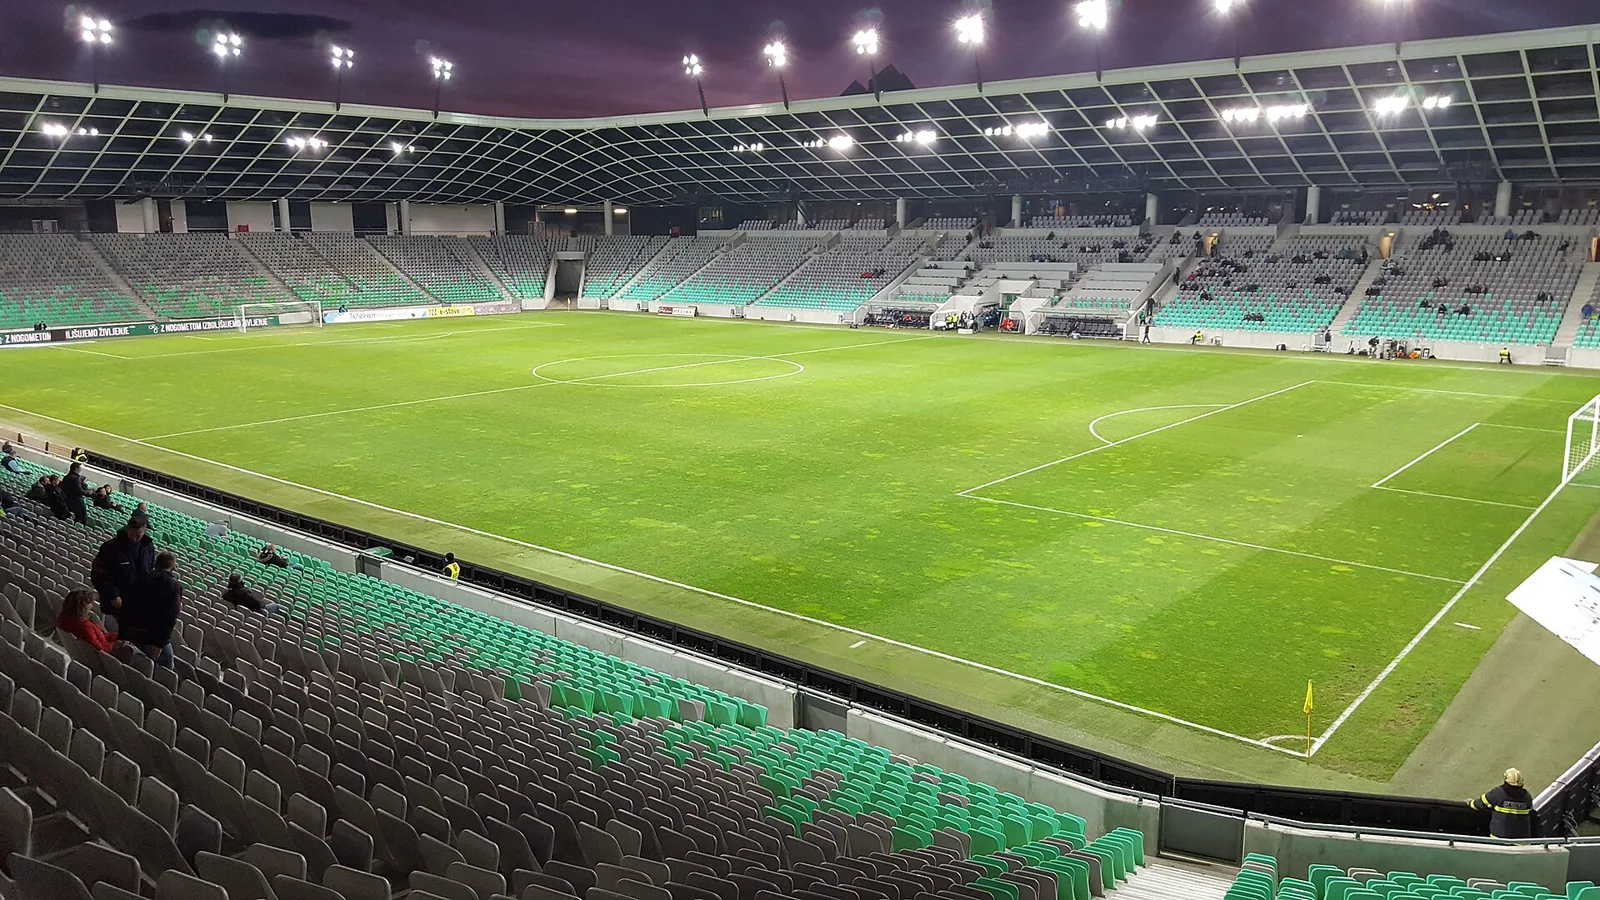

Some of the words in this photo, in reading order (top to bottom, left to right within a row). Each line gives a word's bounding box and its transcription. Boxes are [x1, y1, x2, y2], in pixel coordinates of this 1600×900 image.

[160, 324, 165, 332] Z
[166, 322, 201, 332] NOGOMETOM
[5, 335, 11, 343] Z
